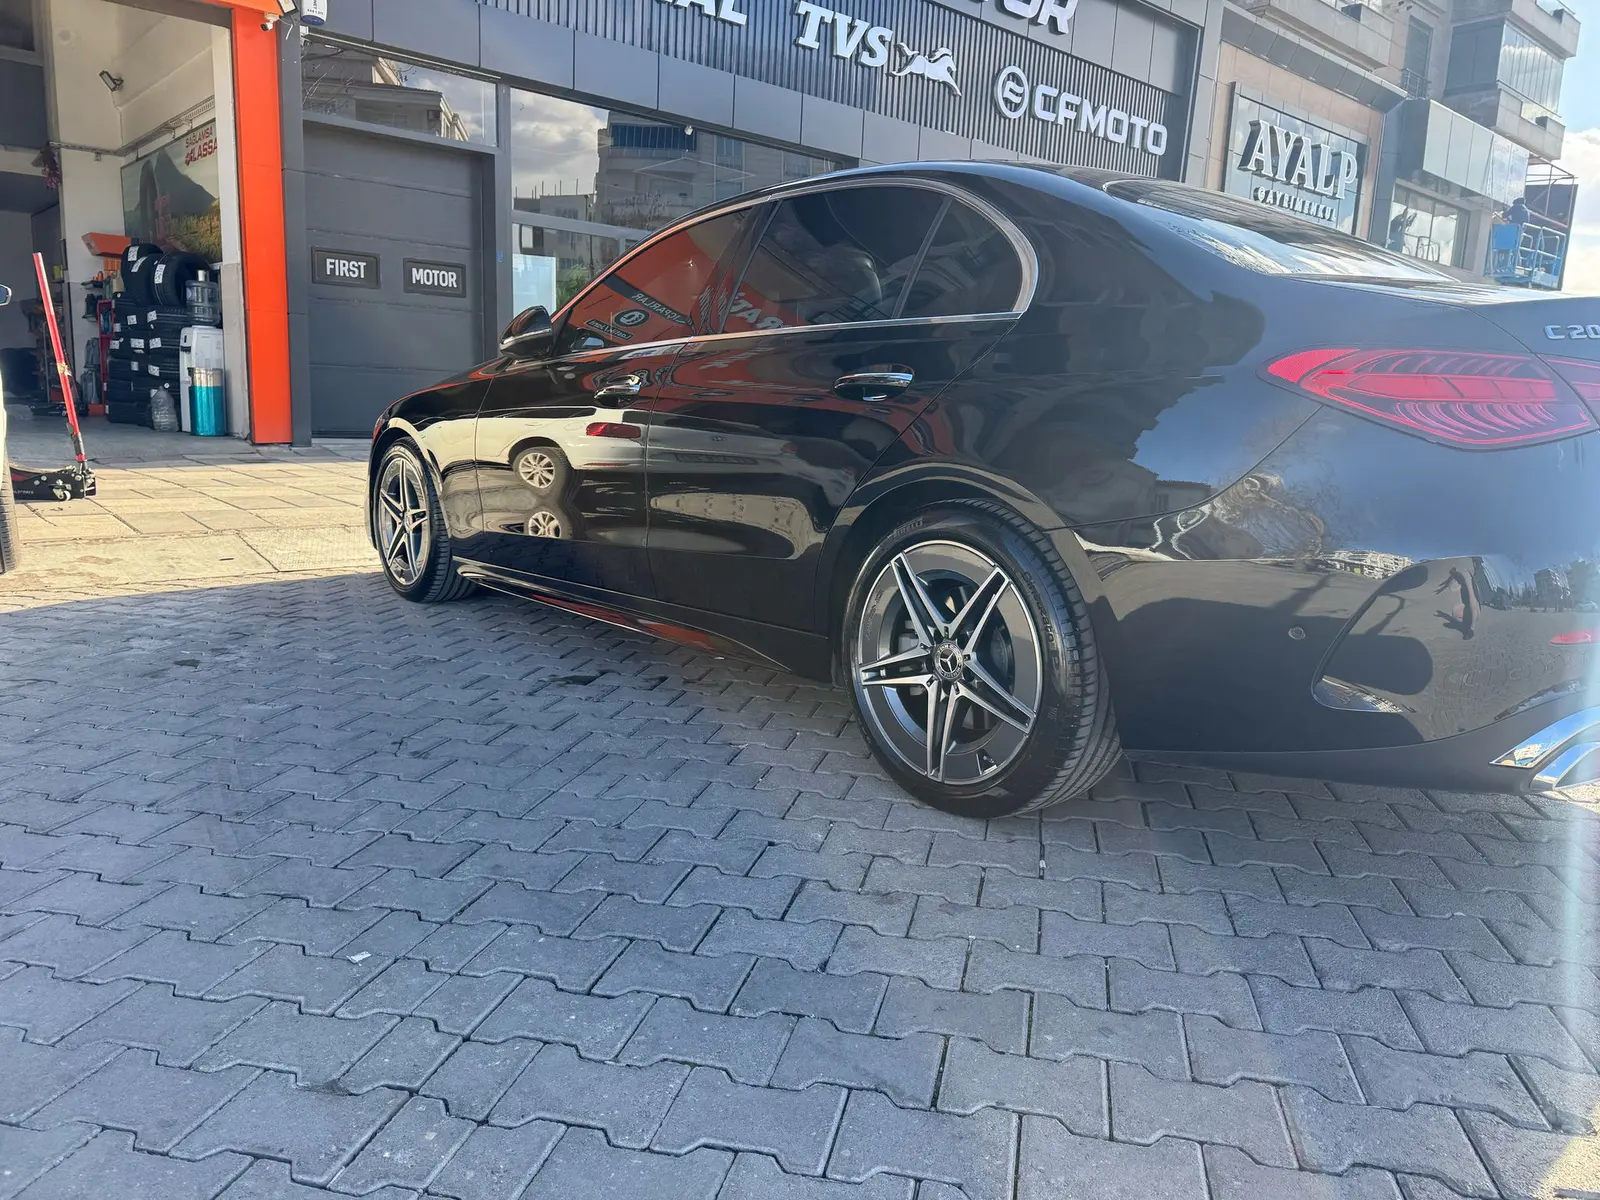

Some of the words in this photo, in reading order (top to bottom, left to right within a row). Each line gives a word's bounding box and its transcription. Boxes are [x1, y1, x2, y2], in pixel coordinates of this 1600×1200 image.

[797, 1, 893, 67] TVS
[1034, 84, 1168, 156] CFMOTO
[1244, 119, 1358, 200] AYALP
[325, 258, 367, 279] FIRST
[411, 267, 458, 288] MOTOR
[1544, 325, 1566, 340] C
